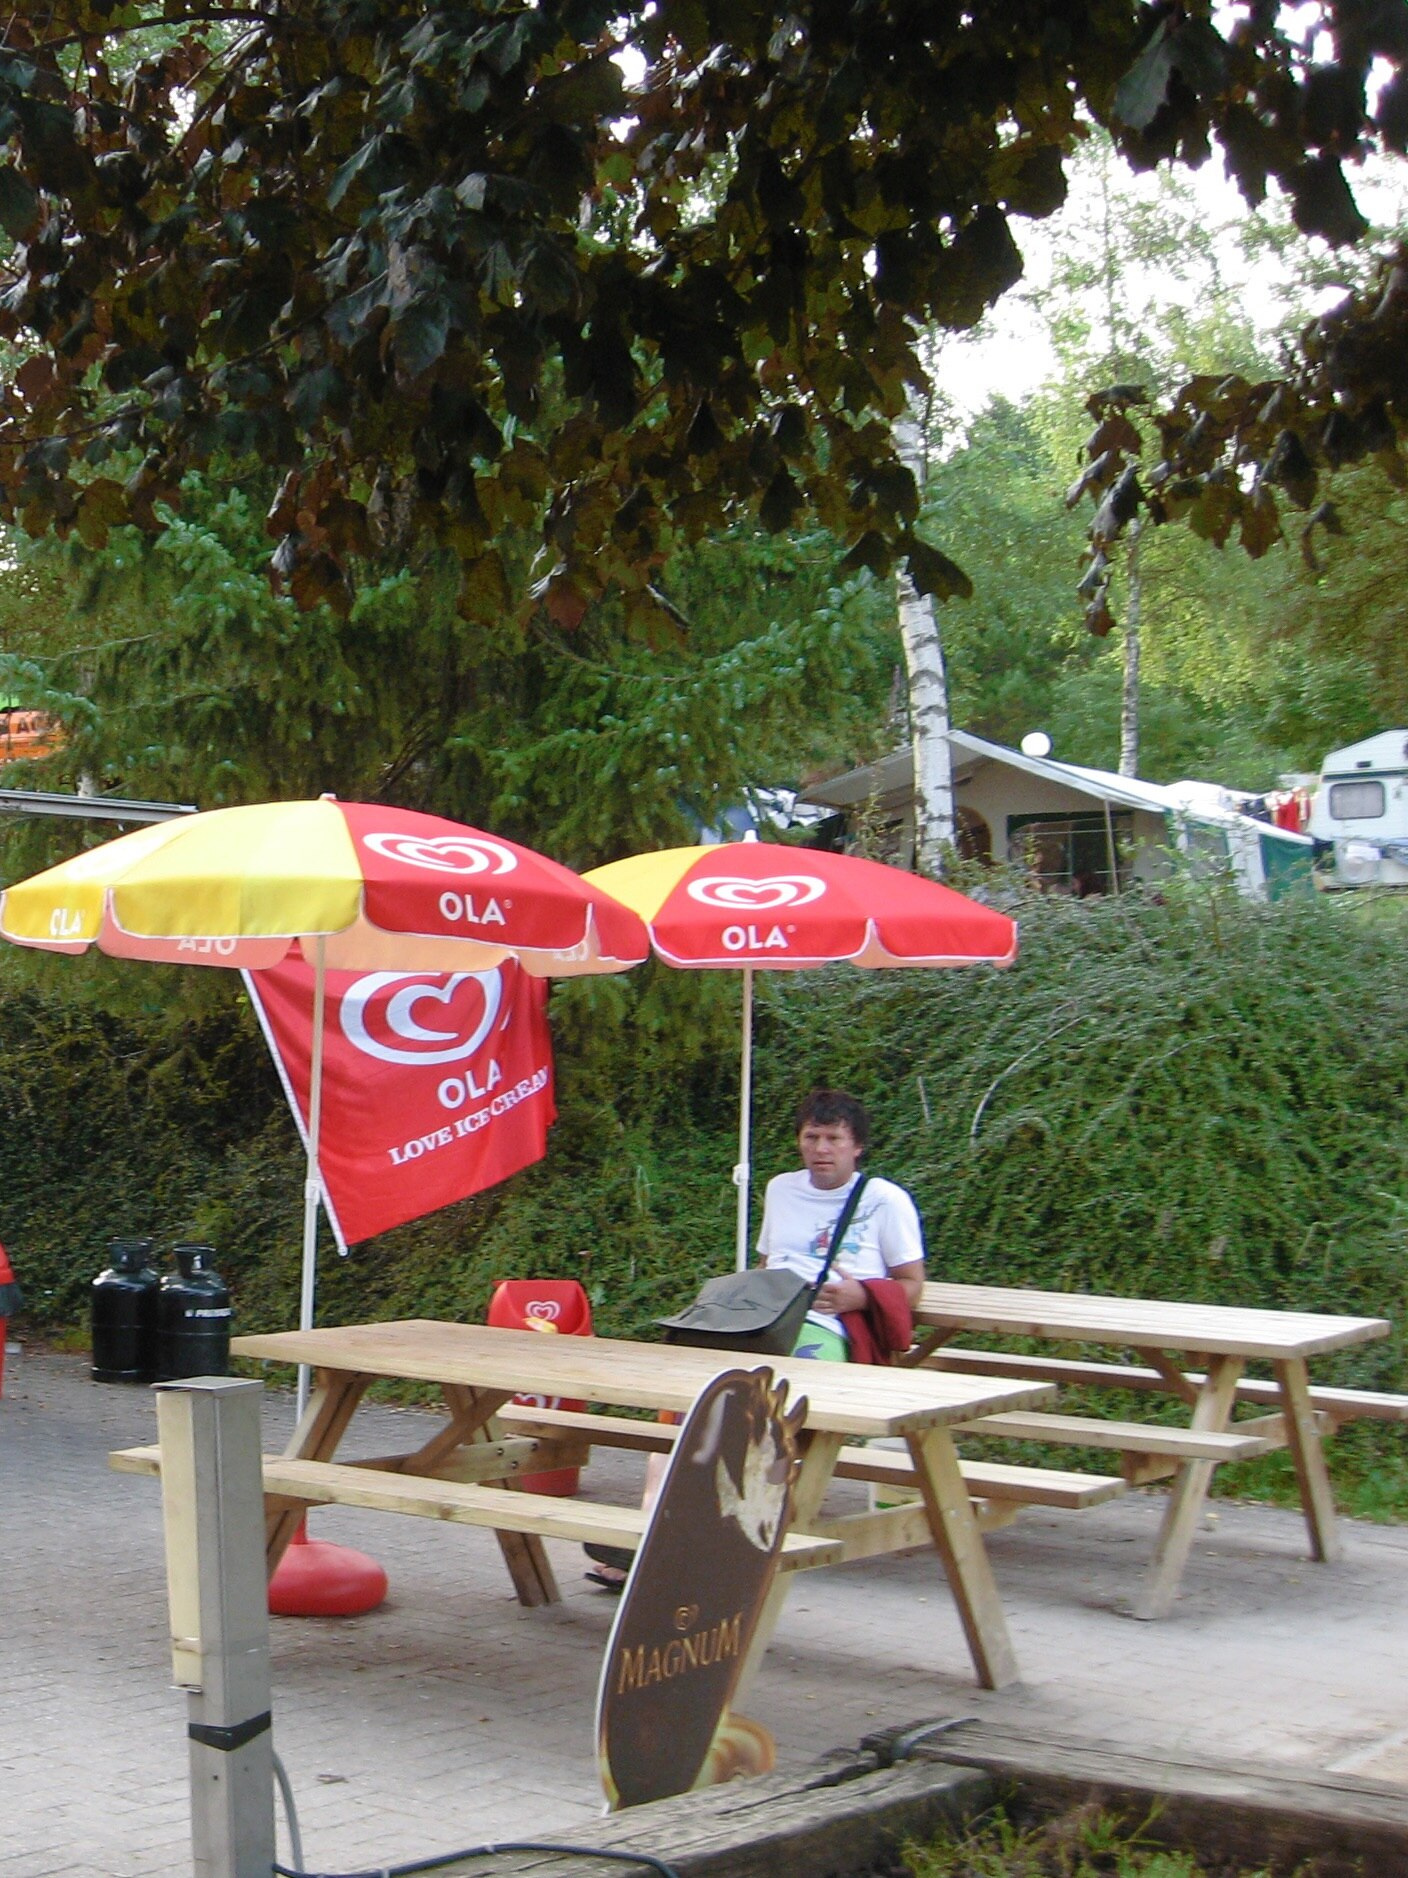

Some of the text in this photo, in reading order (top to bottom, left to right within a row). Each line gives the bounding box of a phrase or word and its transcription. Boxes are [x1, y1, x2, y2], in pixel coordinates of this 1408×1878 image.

[436, 1058, 503, 1109] OLA
[388, 1126, 454, 1166] LOVE
[454, 1107, 491, 1138] ICE
[617, 1611, 743, 1695] MAGNUM
